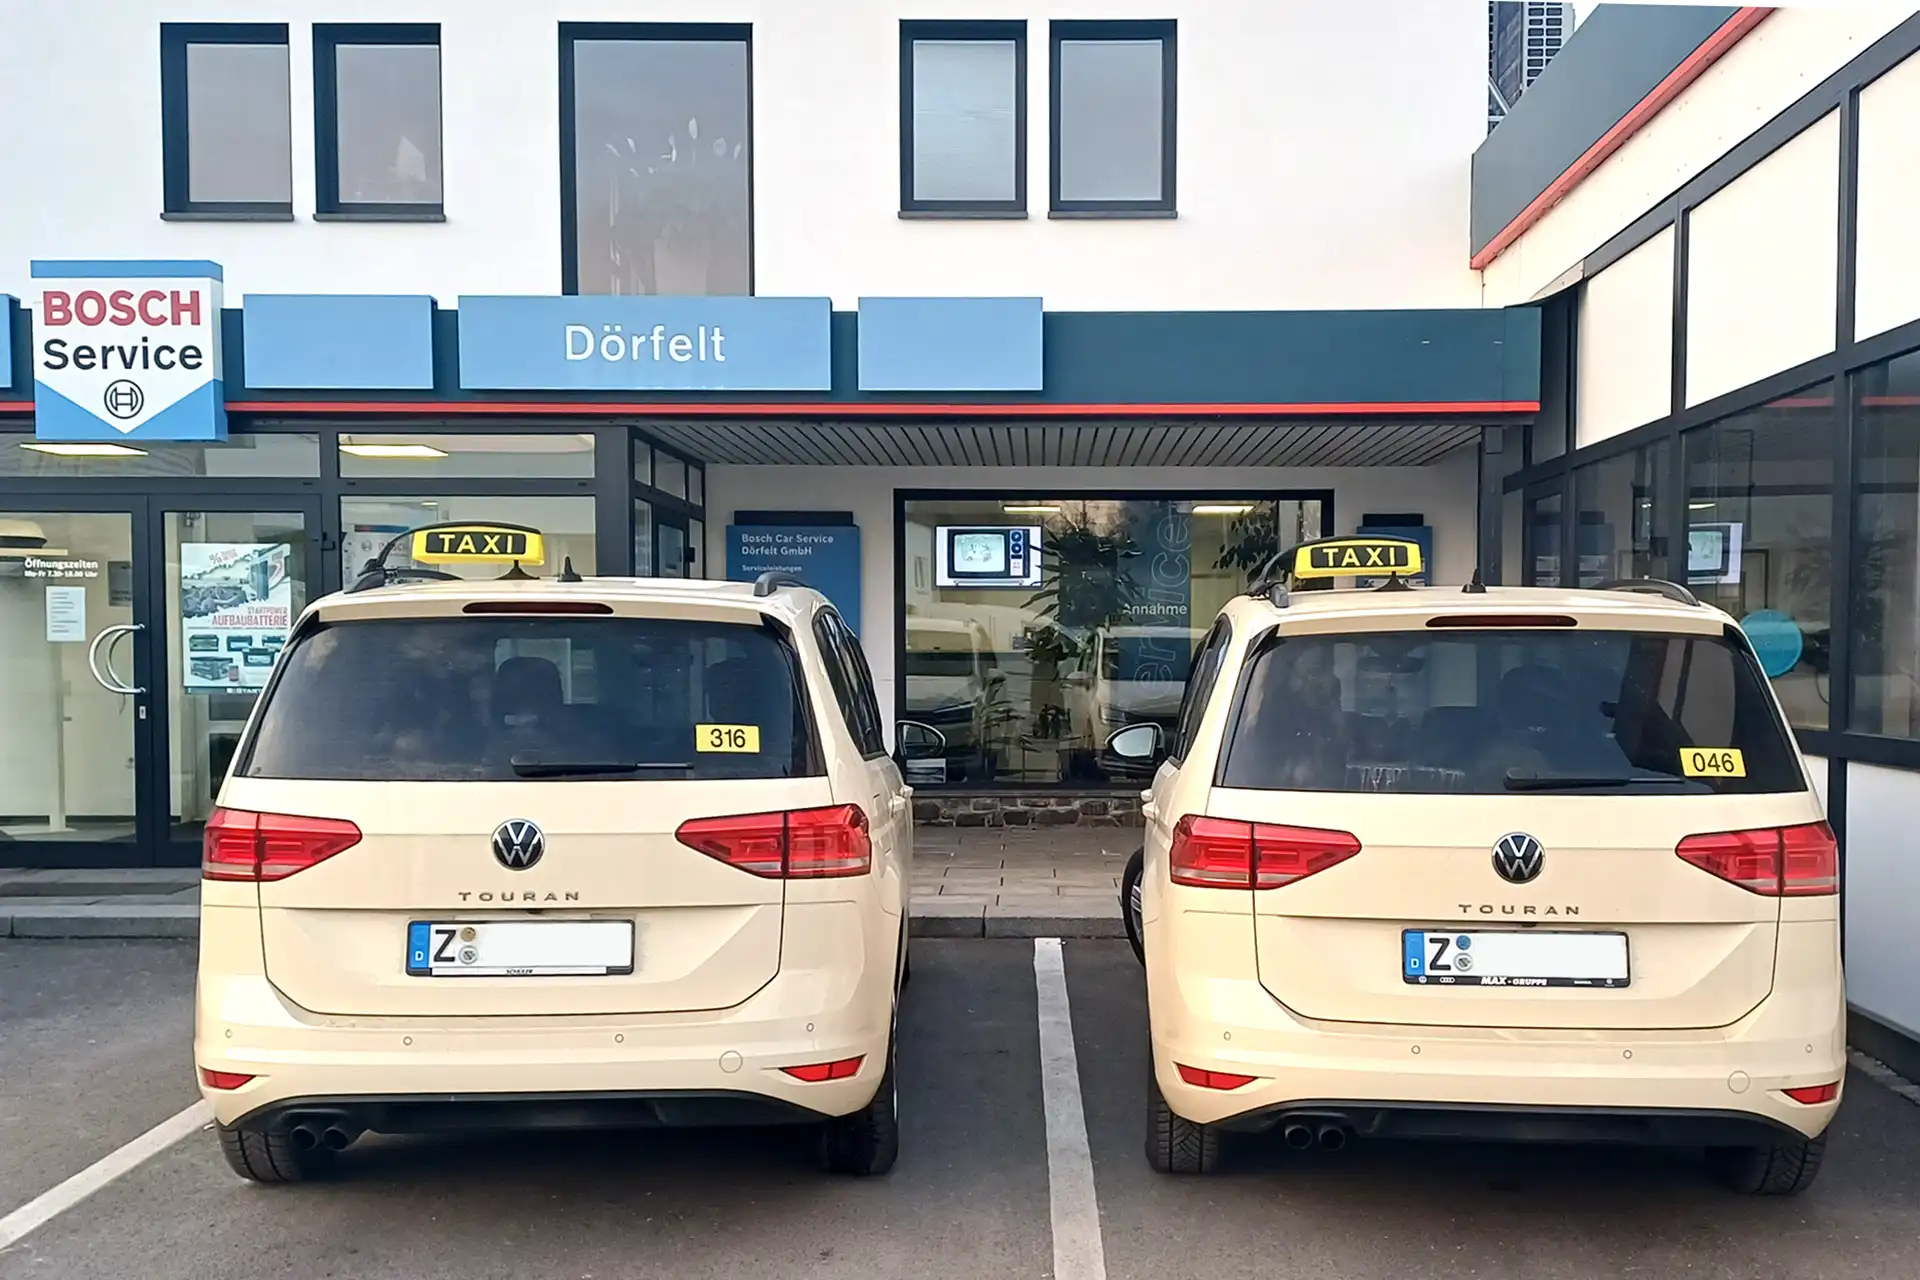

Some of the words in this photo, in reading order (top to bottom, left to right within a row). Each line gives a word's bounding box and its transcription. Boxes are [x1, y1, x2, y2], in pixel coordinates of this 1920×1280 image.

[43, 290, 201, 326] BOSCH
[43, 336, 203, 370] Service
[564, 324, 726, 362] Dörfelt
[438, 534, 513, 554] TAXI
[741, 533, 772, 543] Bosch
[775, 533, 793, 543] Car
[796, 533, 834, 543] Service
[741, 545, 777, 555] Dörfelt
[780, 545, 812, 555] GmbH
[1322, 547, 1396, 567] TAXI
[24, 557, 98, 569] Öffnungszeiten
[211, 614, 288, 626] AUFBAUBATTERIE
[710, 728, 746, 748] 316
[1692, 752, 1735, 773] 046
[458, 891, 580, 902] TOURAN
[1458, 903, 1580, 915] TOURAN
[414, 950, 424, 961] D
[433, 929, 457, 962] Z
[1410, 958, 1420, 968] D
[1428, 938, 1452, 971] Z
[1480, 976, 1507, 985] MAX
